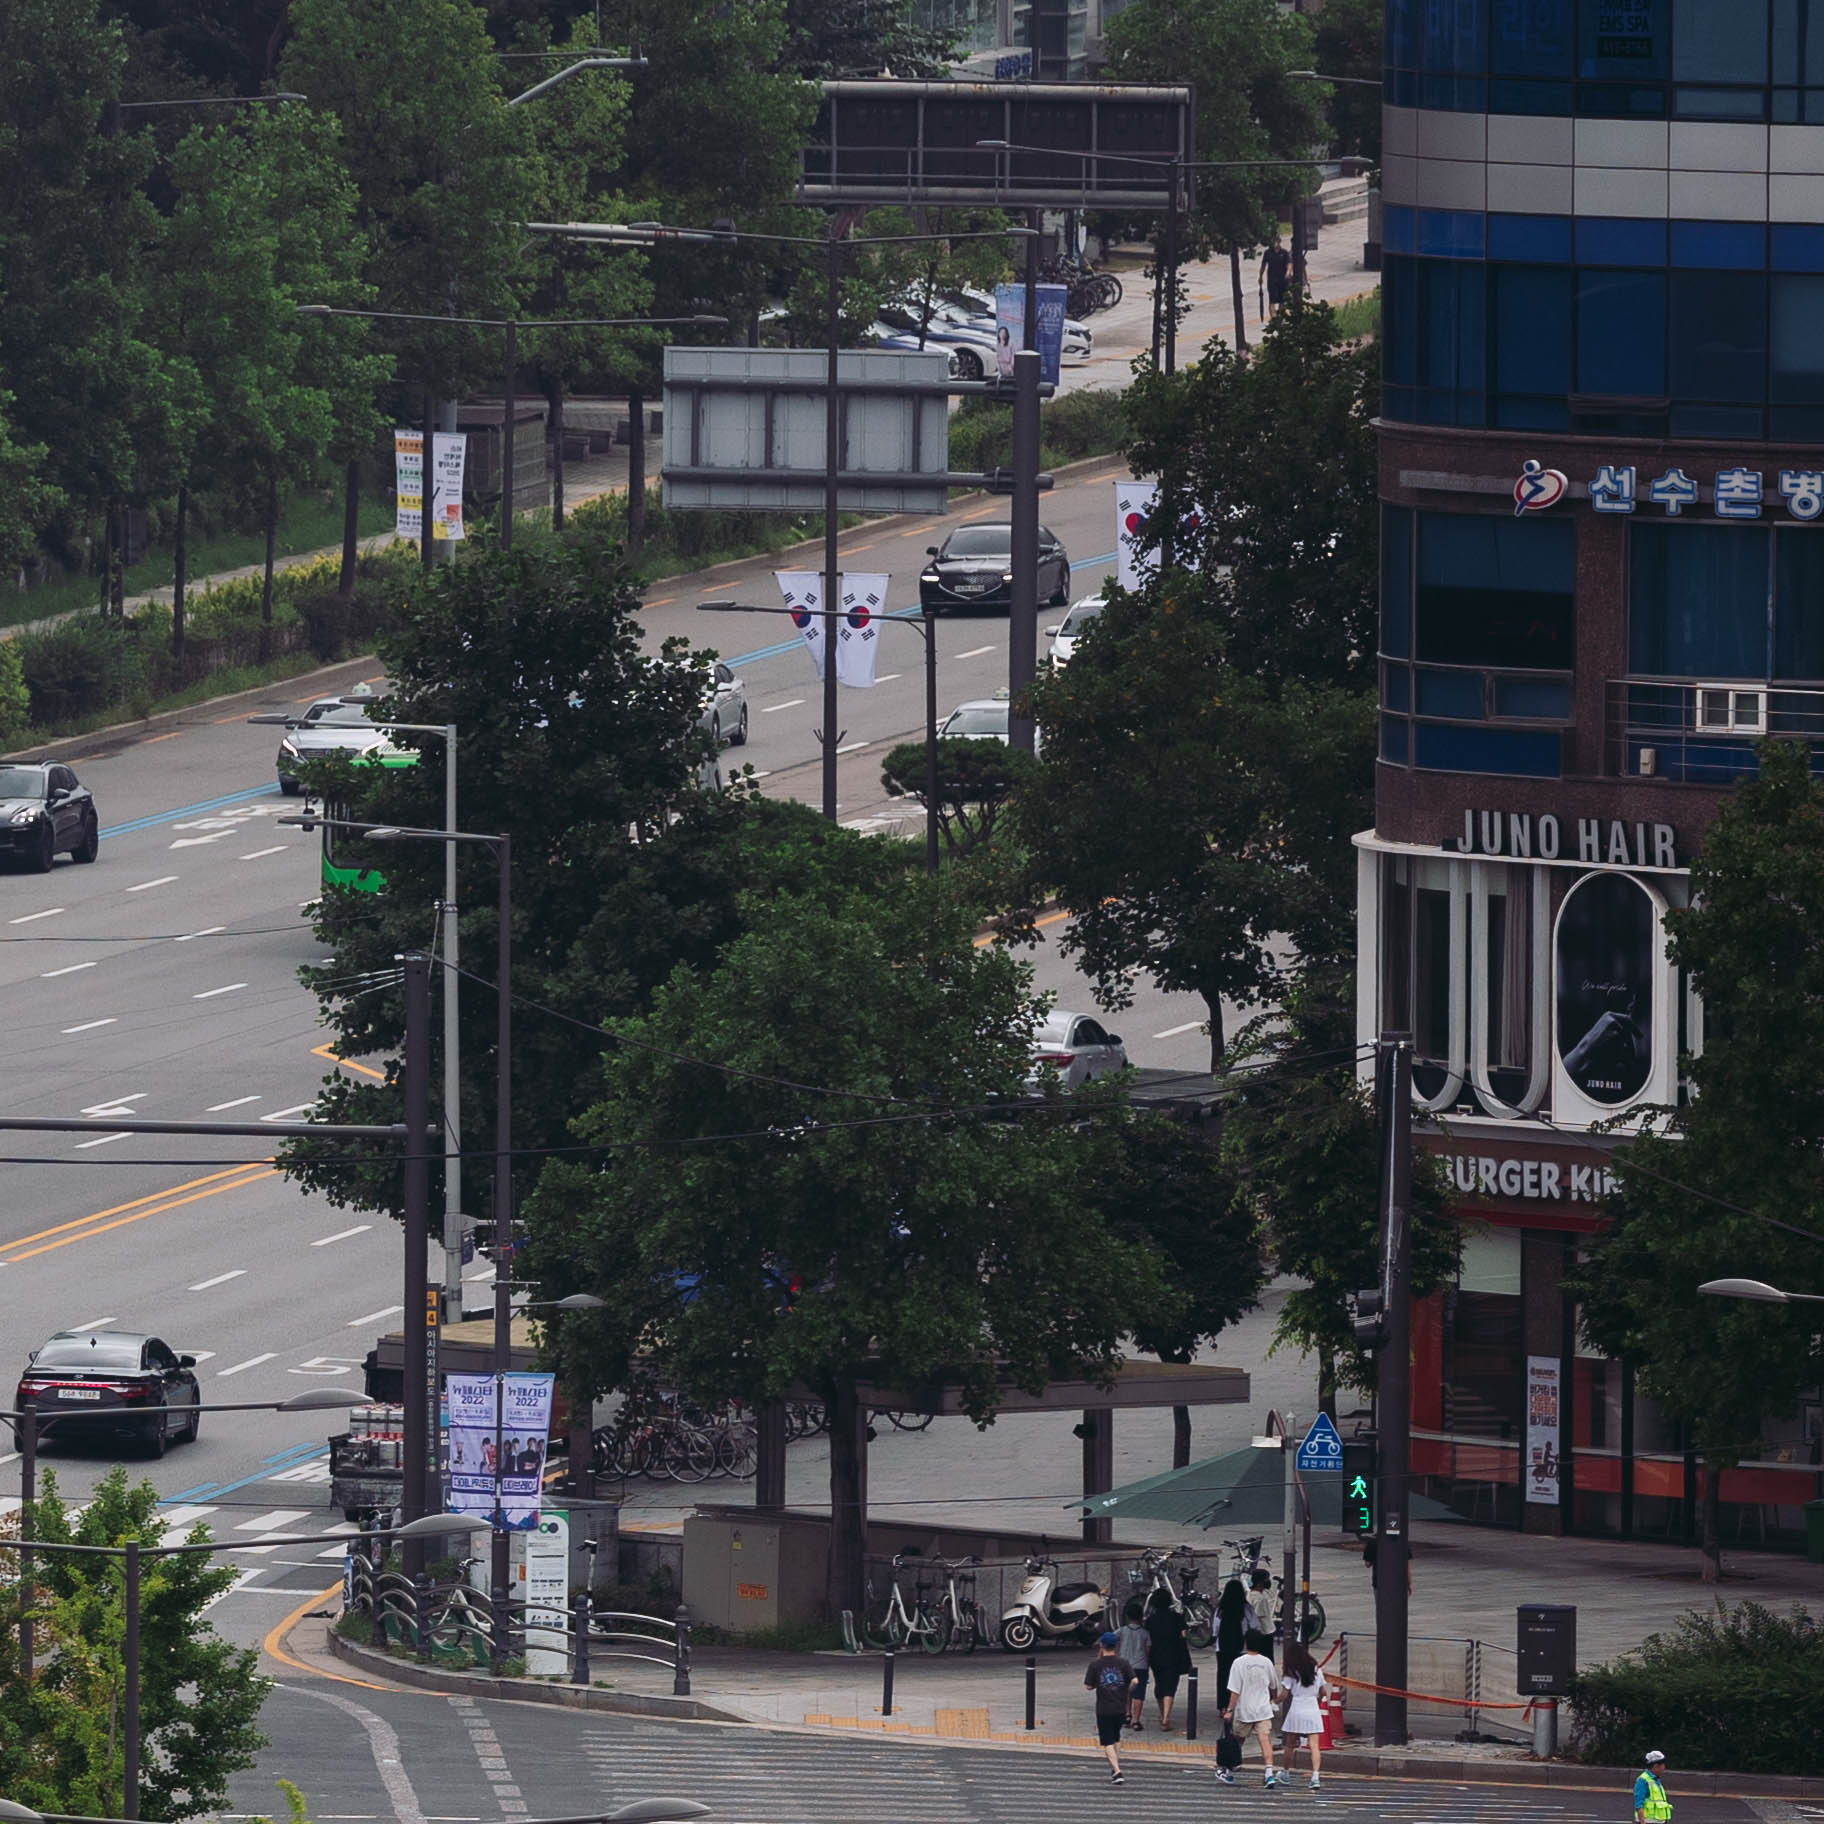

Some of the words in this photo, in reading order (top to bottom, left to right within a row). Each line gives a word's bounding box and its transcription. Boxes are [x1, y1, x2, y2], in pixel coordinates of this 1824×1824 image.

[1457, 808, 1561, 860] JUNO
[1578, 817, 1677, 869] HAIR
[461, 1395, 485, 1405] 2022
[515, 1397, 539, 1407] 2022
[1359, 1507, 1370, 1529] 3
